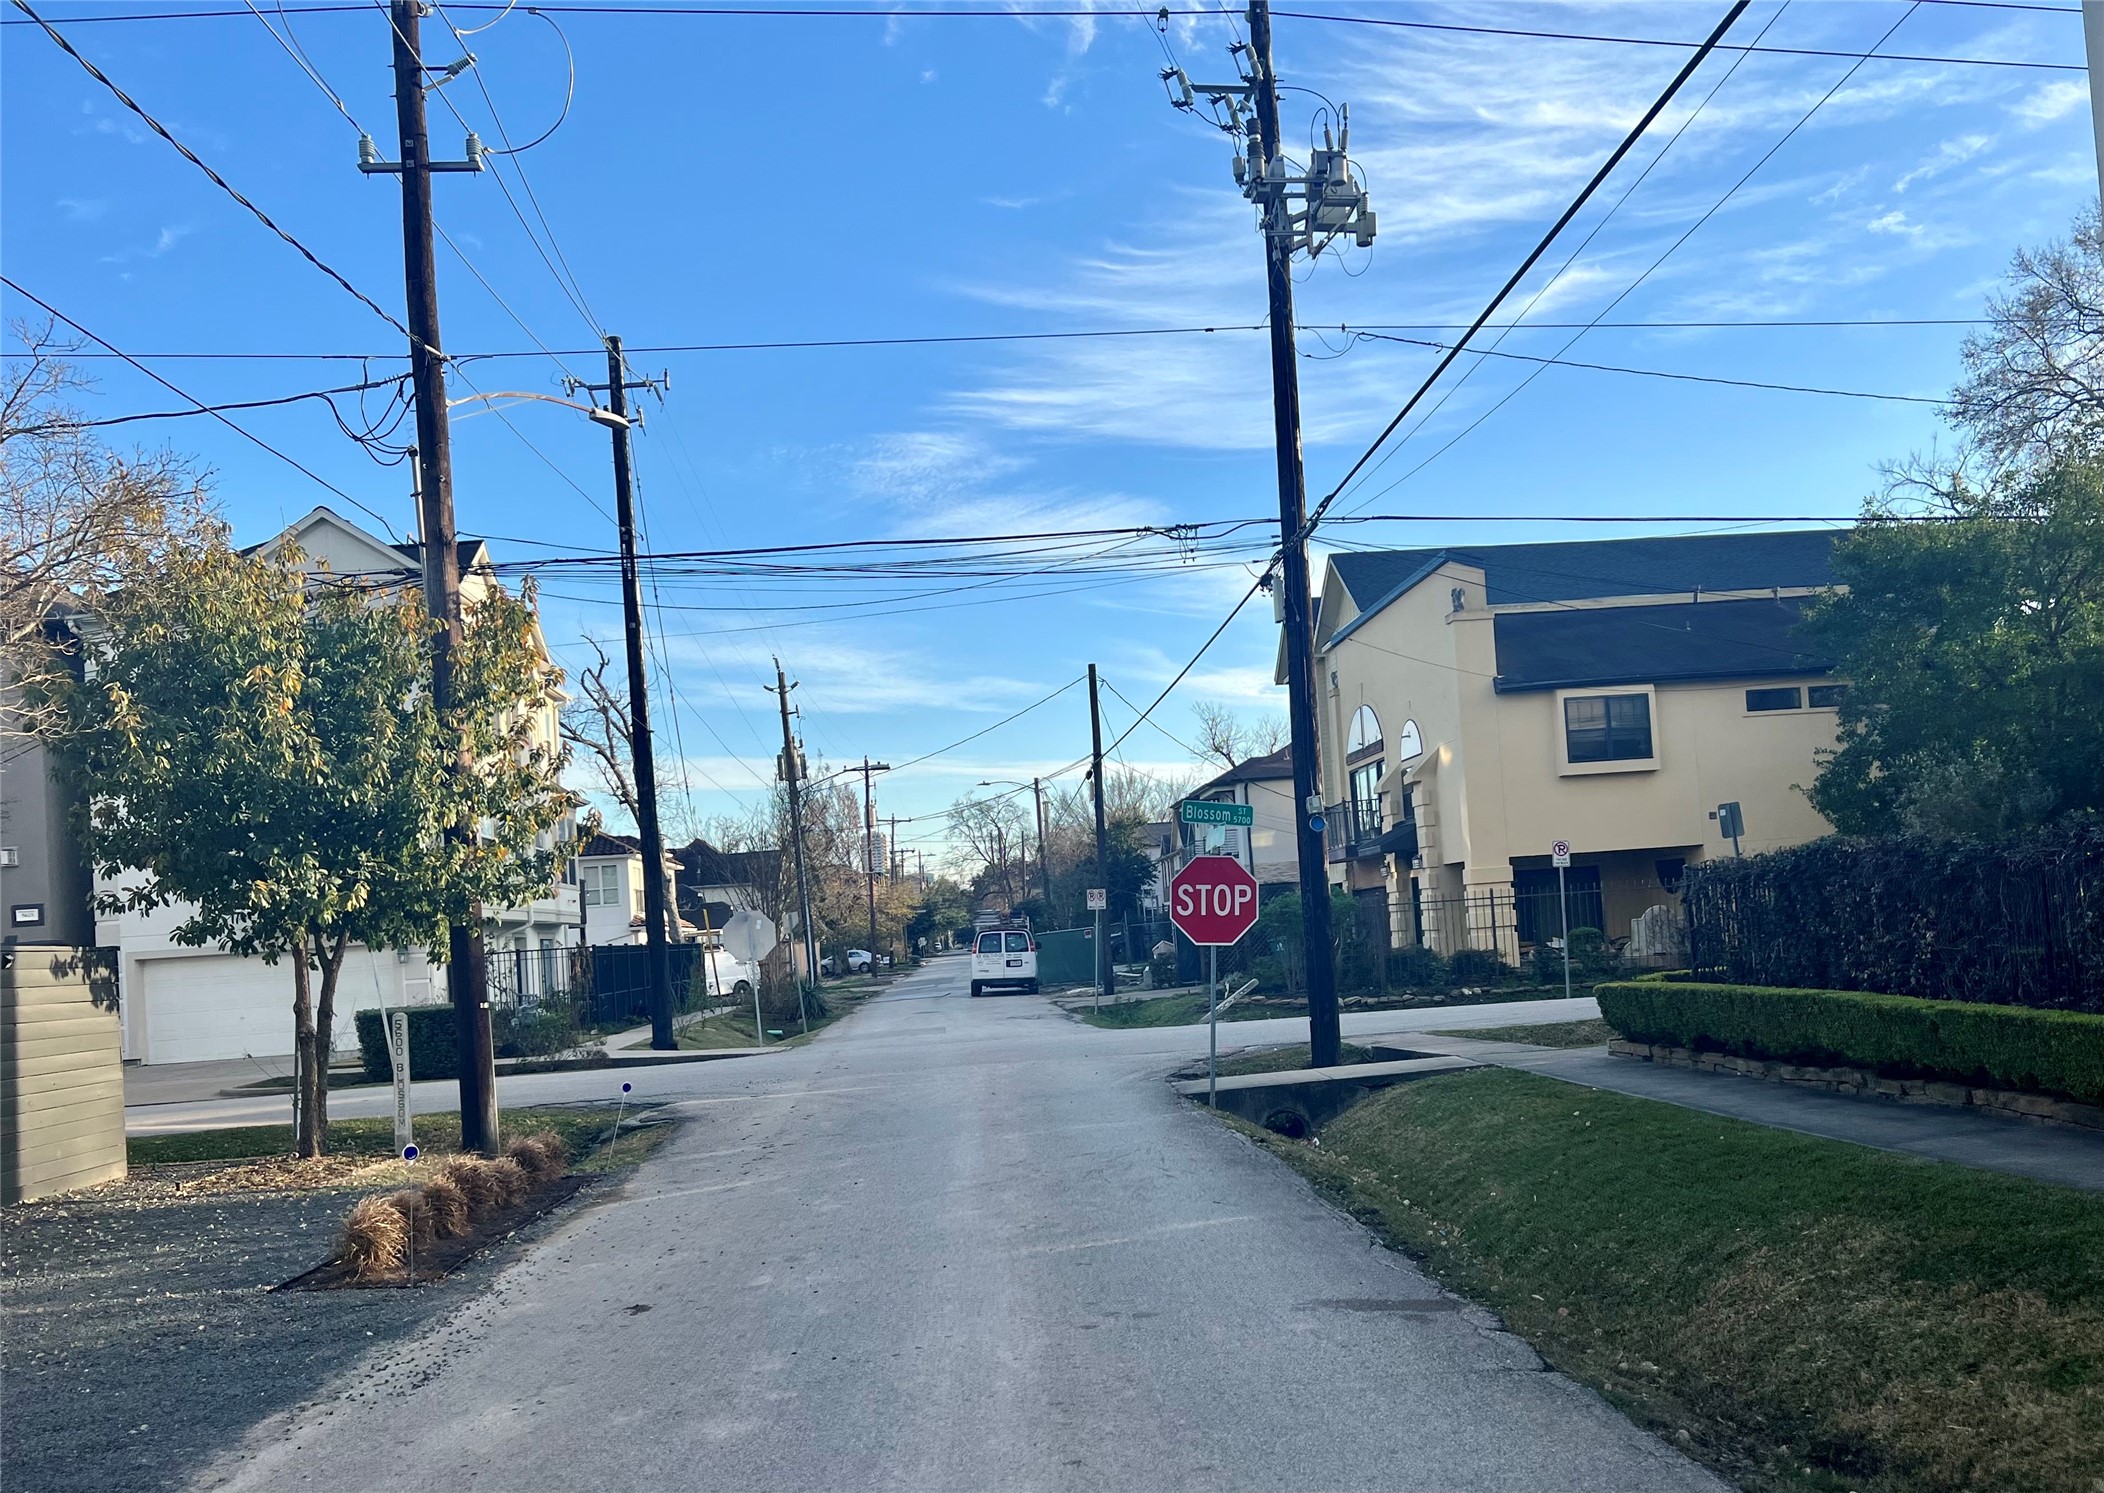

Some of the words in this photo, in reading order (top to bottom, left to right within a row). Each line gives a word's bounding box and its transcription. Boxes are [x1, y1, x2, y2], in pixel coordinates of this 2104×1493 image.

[1185, 804, 1231, 822] Blossom
[1238, 807, 1247, 815] ST
[1233, 815, 1251, 824] 5700
[1176, 883, 1252, 917] STOP
[394, 1019, 403, 1057] 5600
[396, 1063, 406, 1128] BLOSSOM
